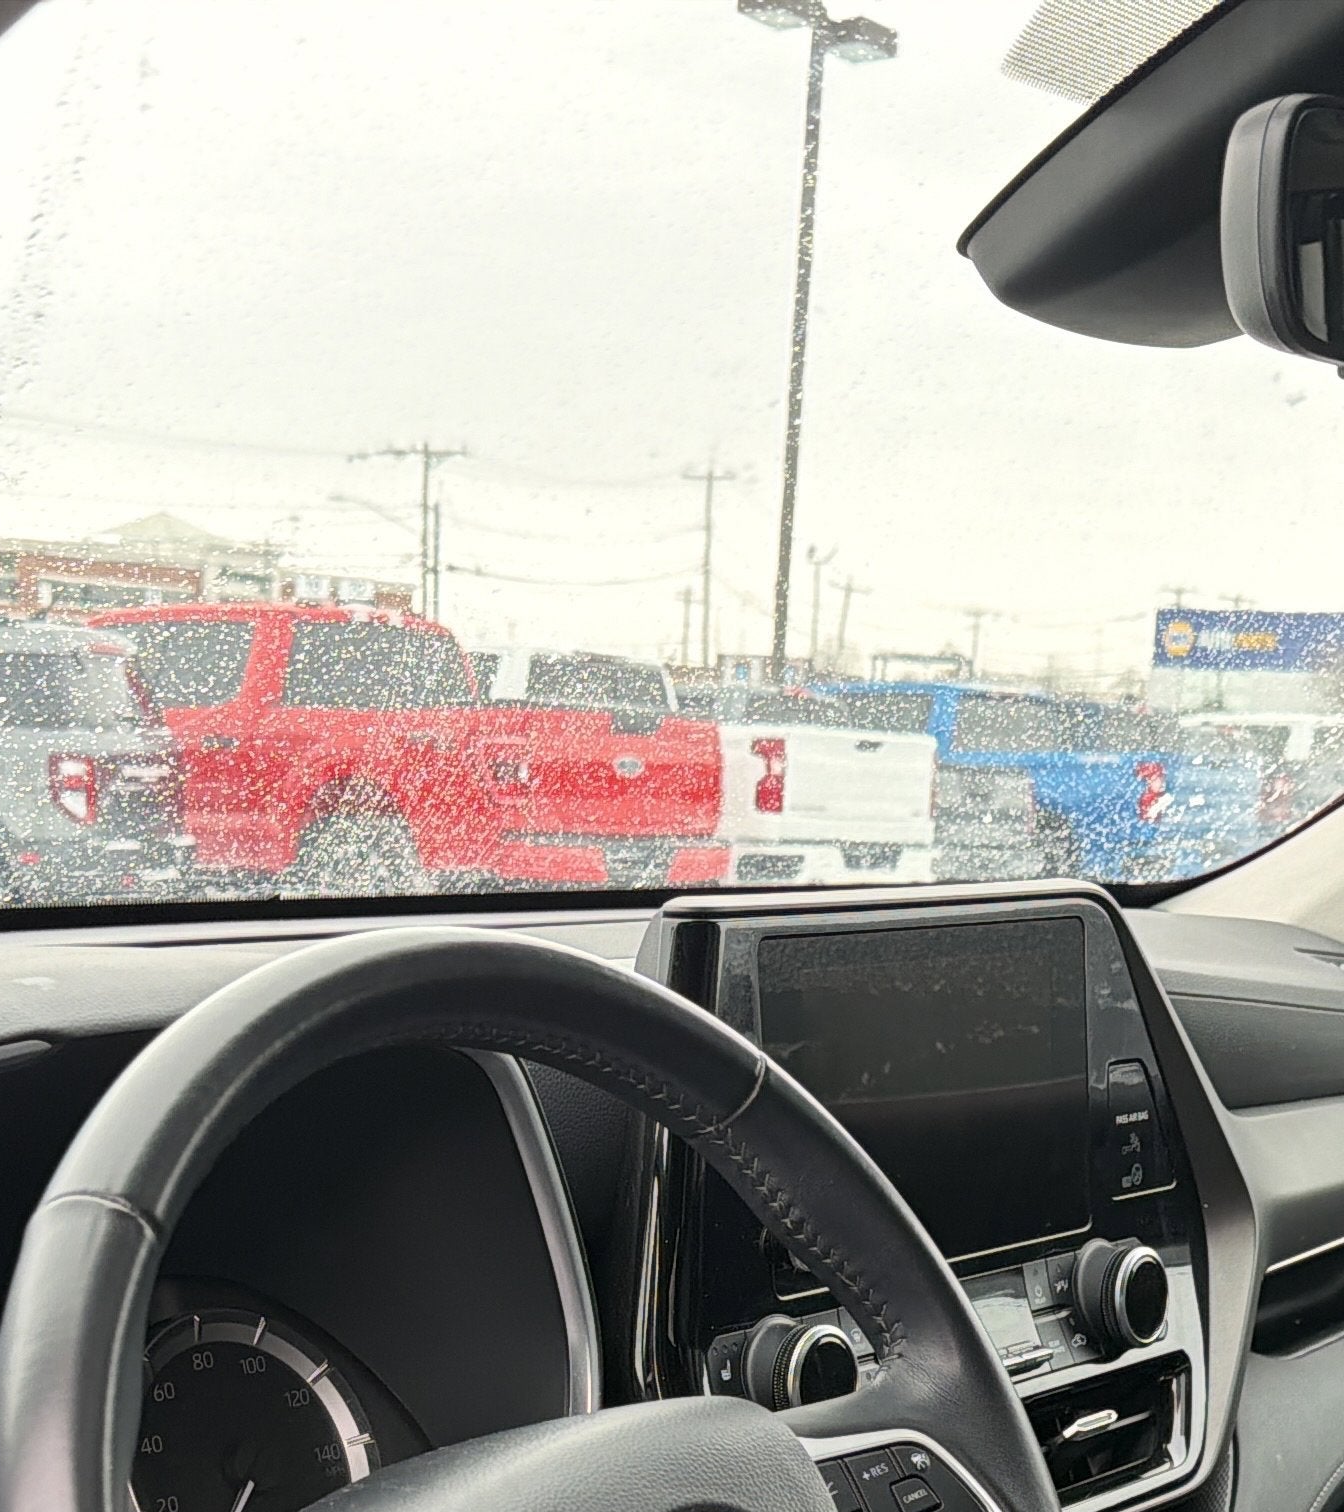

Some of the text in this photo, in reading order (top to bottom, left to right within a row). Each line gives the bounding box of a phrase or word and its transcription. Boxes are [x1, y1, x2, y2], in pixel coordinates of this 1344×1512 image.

[193, 1351, 214, 1370] 80
[239, 1355, 266, 1375] 100
[154, 1382, 175, 1402] 60
[284, 1388, 310, 1408] 120
[141, 1435, 163, 1454] 40
[314, 1443, 341, 1463] 140
[902, 1487, 929, 1504] CANCEL
